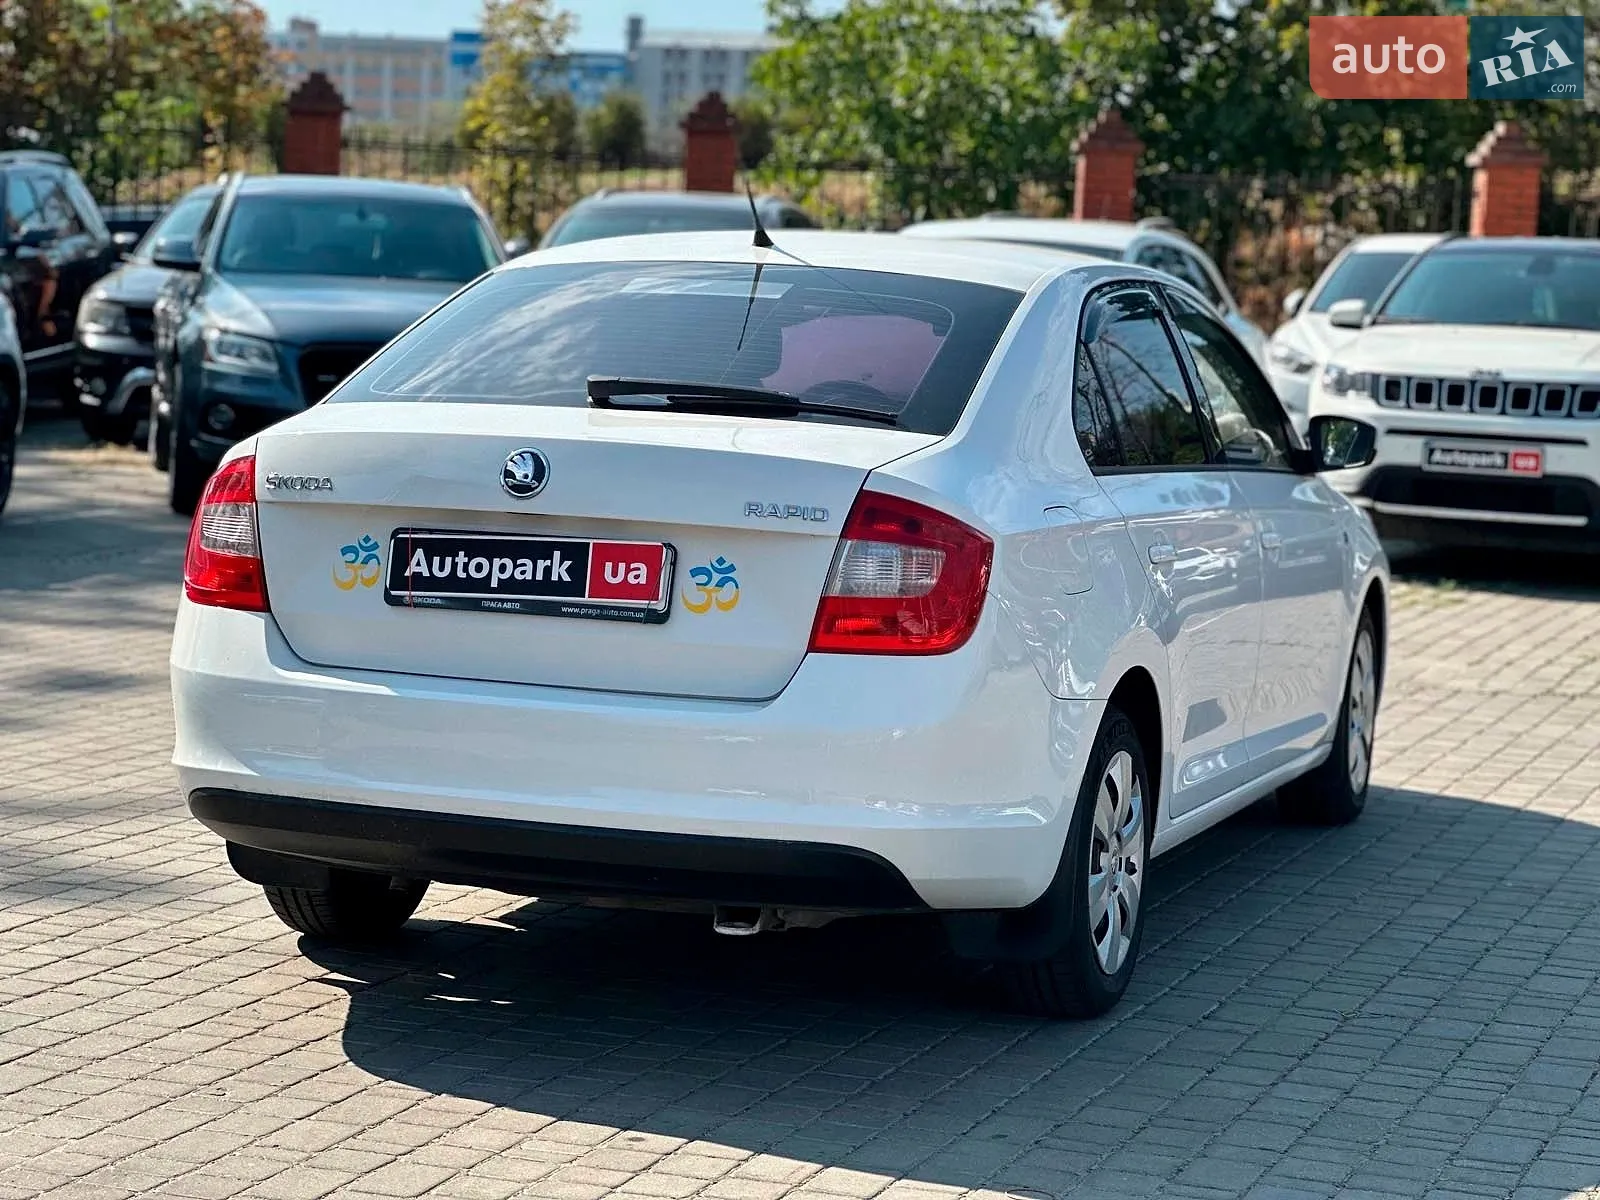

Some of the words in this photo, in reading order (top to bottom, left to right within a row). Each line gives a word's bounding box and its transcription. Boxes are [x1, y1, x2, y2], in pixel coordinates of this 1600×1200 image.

[744, 501, 829, 521] RAPID
[404, 548, 573, 587] Autopark
[604, 562, 647, 584] ua
